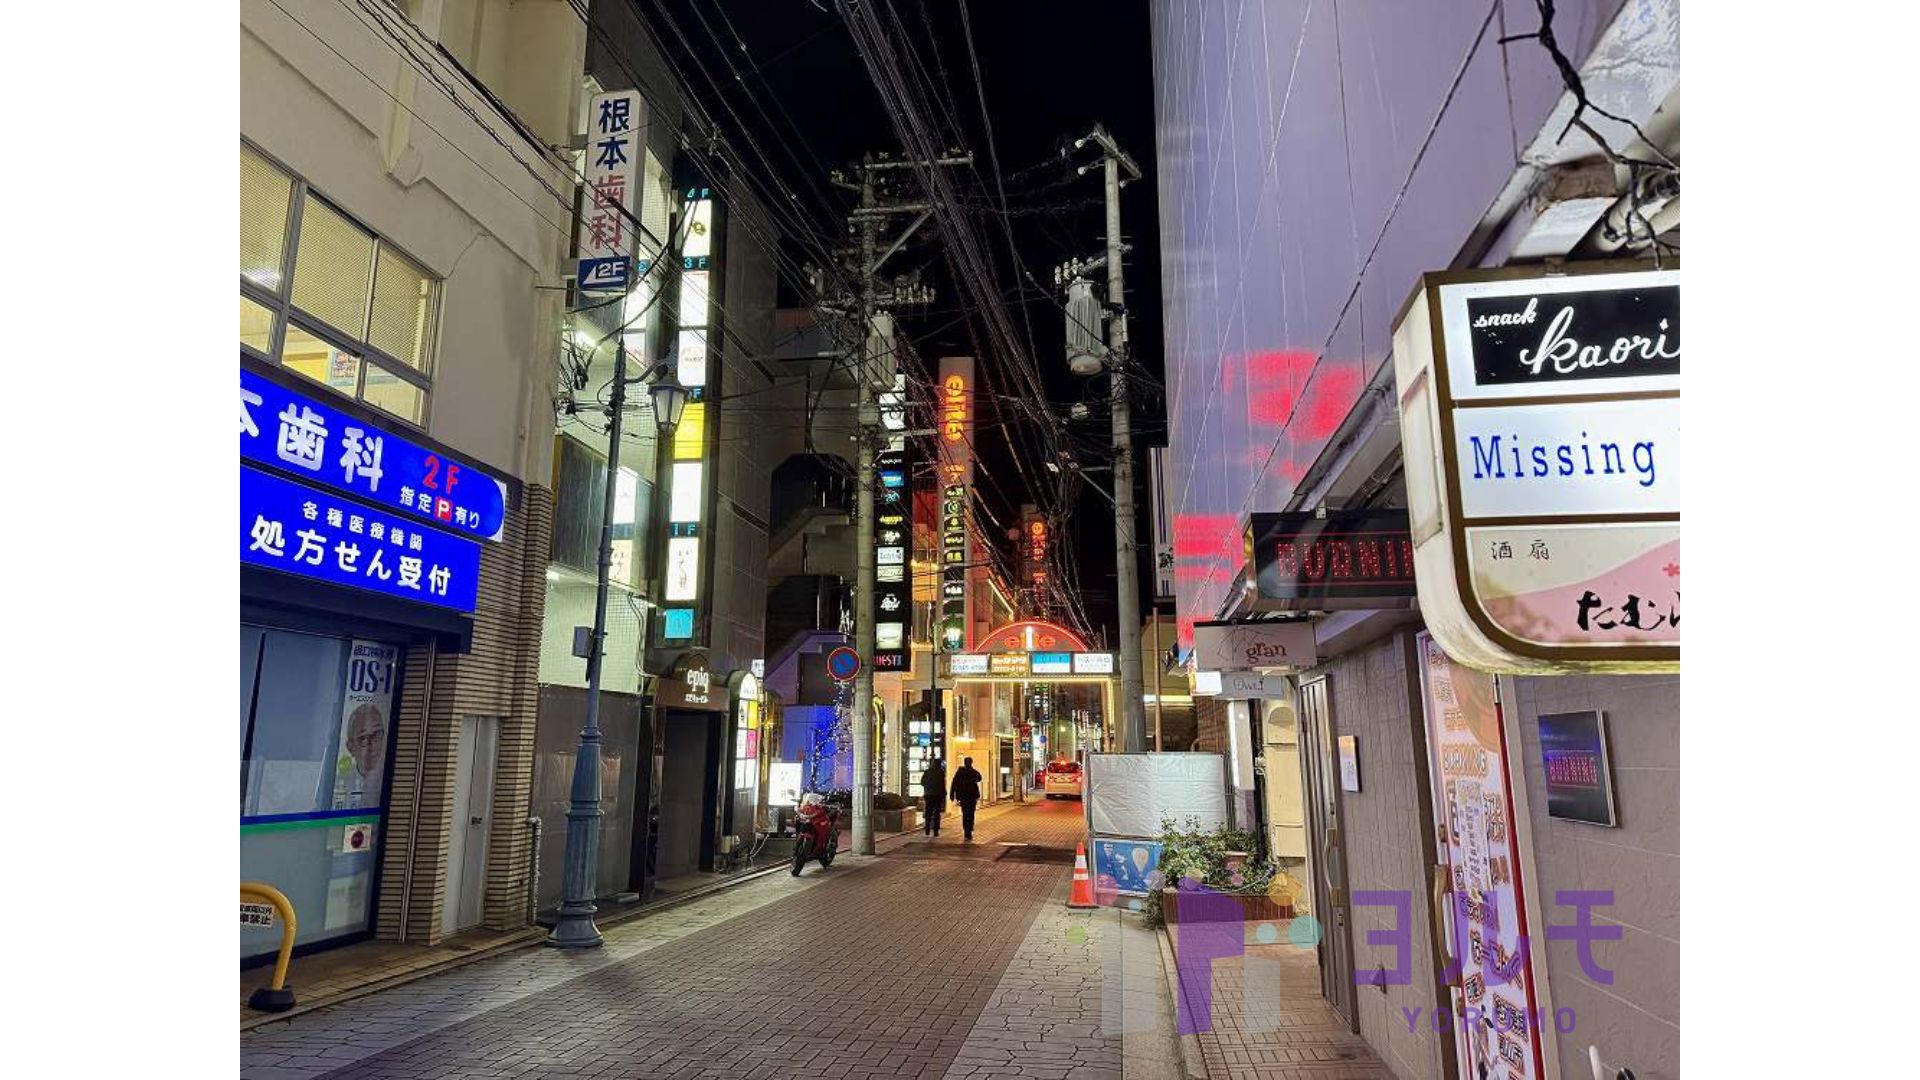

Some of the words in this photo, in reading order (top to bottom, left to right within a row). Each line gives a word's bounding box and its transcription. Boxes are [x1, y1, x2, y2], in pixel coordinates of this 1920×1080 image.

[589, 97, 631, 250] 根本歯科
[597, 262, 625, 277] 2F
[1473, 297, 1538, 327] snack
[1519, 306, 1680, 375] kaori
[422, 455, 461, 494] 2F
[1470, 431, 1656, 487] Missing
[303, 501, 423, 551] 各種医療機関
[249, 514, 452, 596] 処方せん受付
[1246, 642, 1288, 664] gran
[350, 659, 392, 694] OS-1
